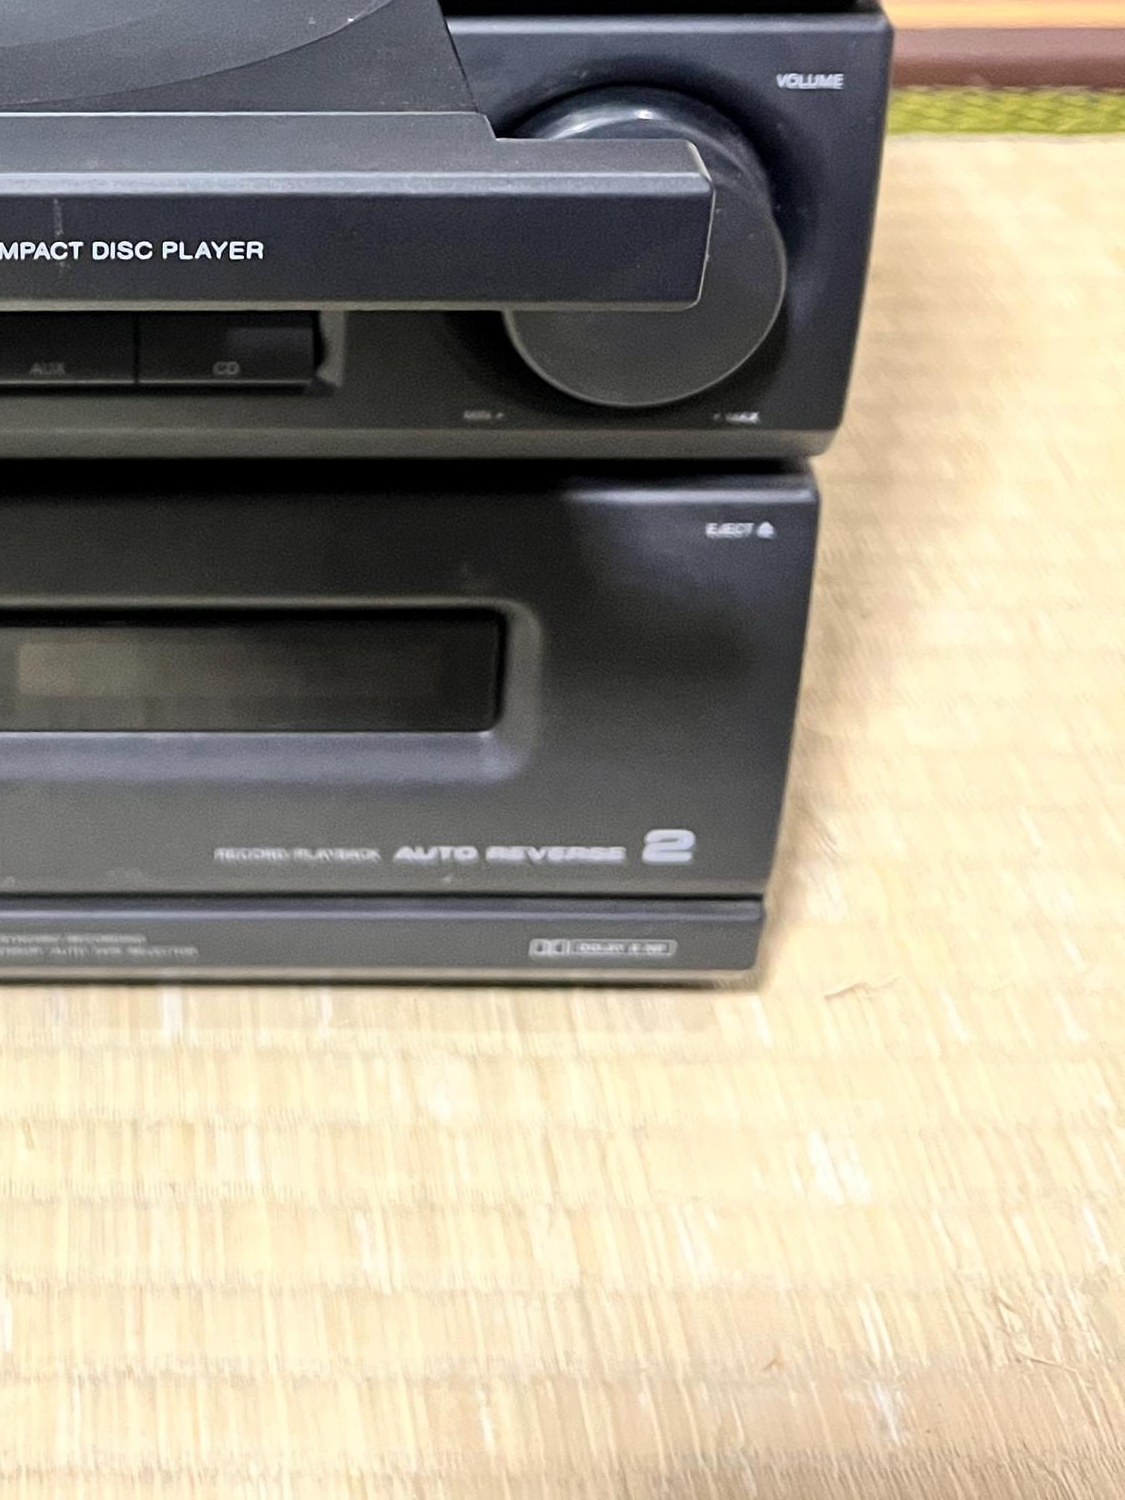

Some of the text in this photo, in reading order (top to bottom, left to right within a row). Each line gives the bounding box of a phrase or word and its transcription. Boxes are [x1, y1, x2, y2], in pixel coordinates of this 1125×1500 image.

[776, 73, 844, 89] VOLUME
[91, 242, 154, 260] DISC
[162, 241, 265, 260] PLAYER
[29, 362, 66, 375] AUX
[213, 361, 240, 375] CD
[706, 523, 755, 538] EJECT
[392, 845, 478, 862] AUTO
[486, 845, 626, 861] REVERSE
[643, 829, 695, 862] 2
